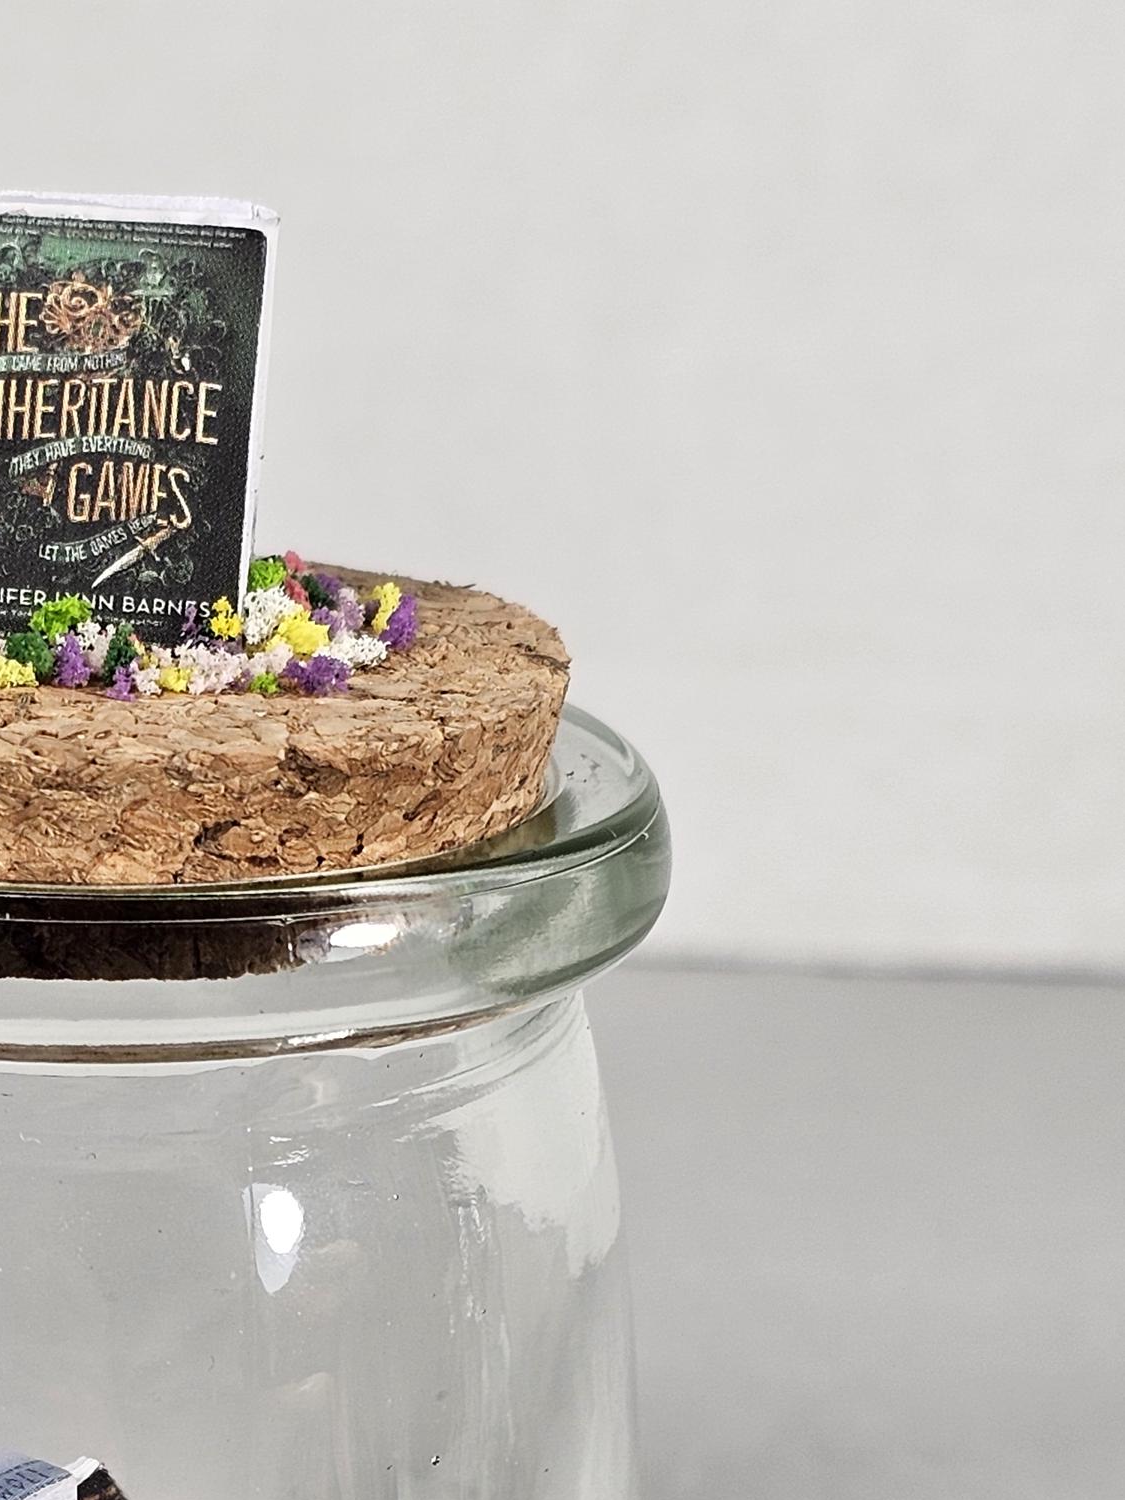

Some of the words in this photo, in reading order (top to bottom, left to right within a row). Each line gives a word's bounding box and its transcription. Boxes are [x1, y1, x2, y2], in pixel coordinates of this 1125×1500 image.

[46, 354, 78, 373] FROM
[45, 437, 77, 463] HAVE
[81, 436, 152, 460] EVERYTHING
[68, 461, 192, 530] GAMES
[38, 543, 59, 562] LET
[65, 543, 88, 562] THE
[89, 526, 128, 557] GAMES
[121, 595, 211, 619] BARNES
